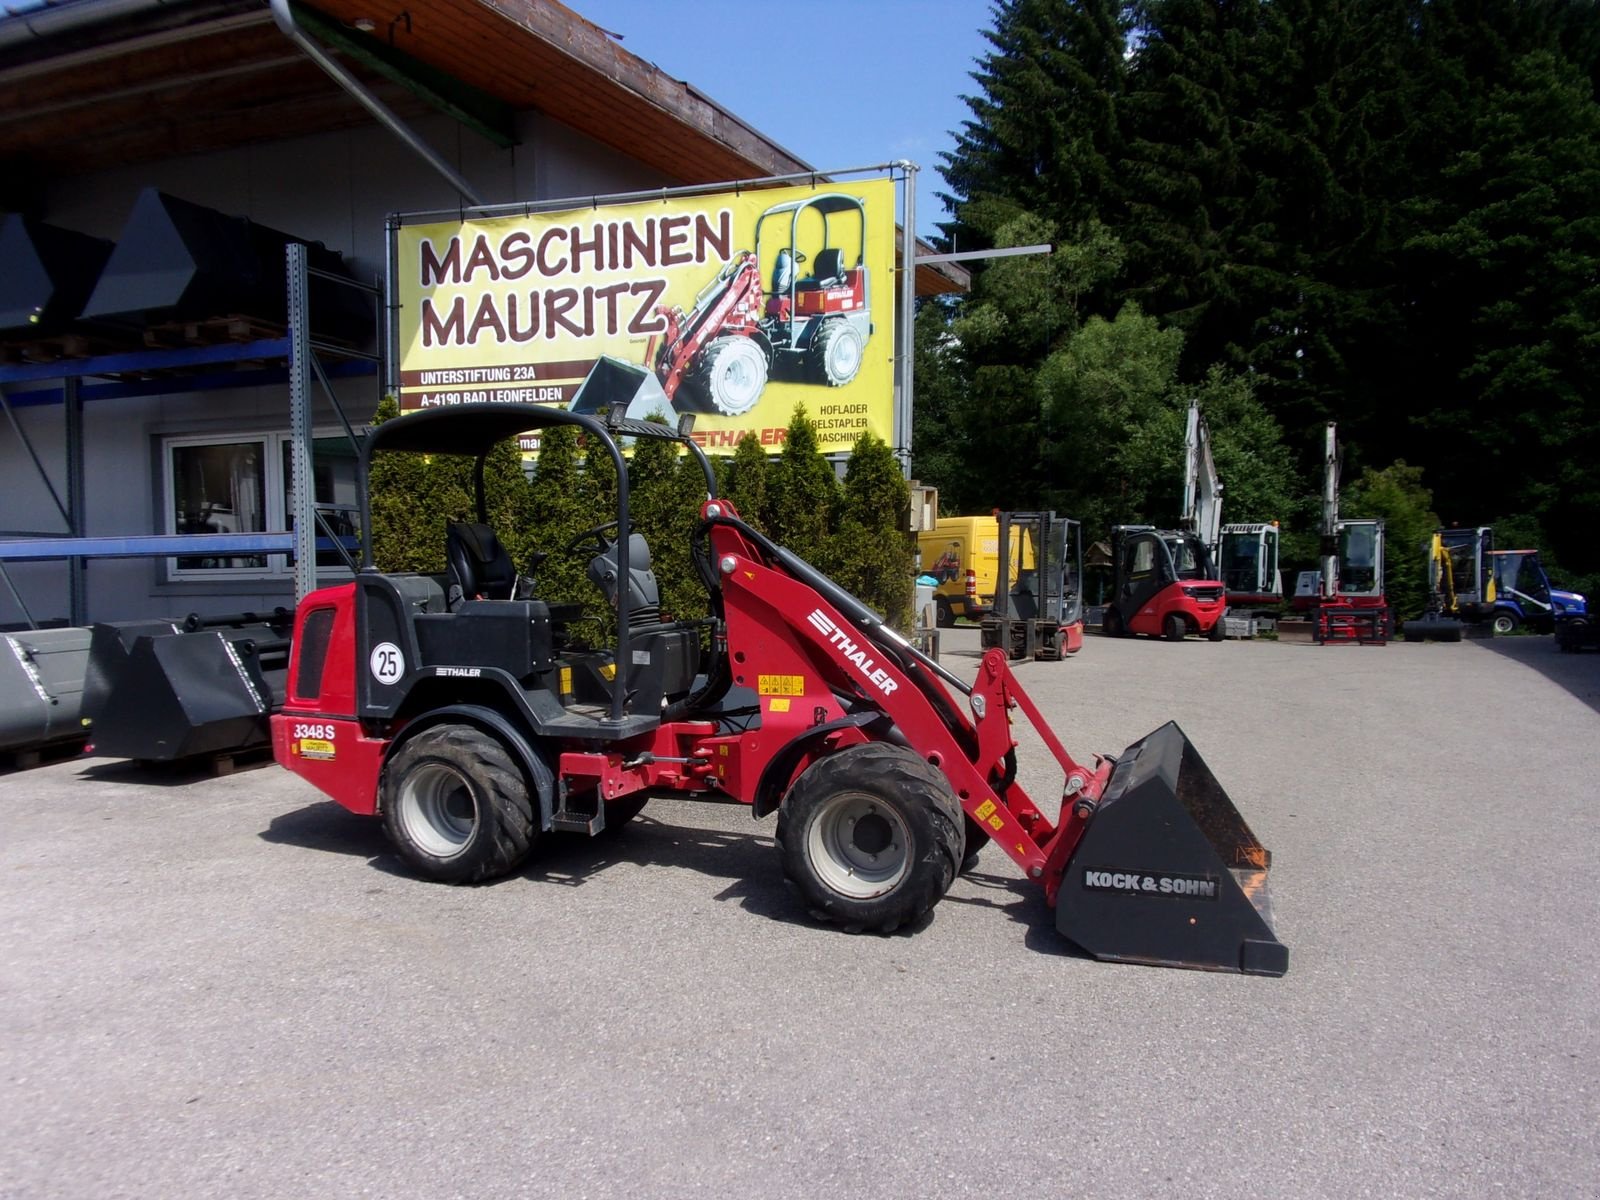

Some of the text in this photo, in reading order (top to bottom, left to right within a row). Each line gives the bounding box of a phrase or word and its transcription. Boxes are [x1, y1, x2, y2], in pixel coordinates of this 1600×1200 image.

[421, 211, 730, 286] MASCHINEN
[421, 279, 667, 347] MAURITZ
[421, 366, 536, 385] UNTERSTIFTUNG 23A
[420, 387, 562, 407] A-4190 BAD LEONFELDEN
[820, 404, 868, 415] HOFLADER
[378, 651, 397, 677] 25
[1086, 871, 1215, 897] KOCK & SOHN
